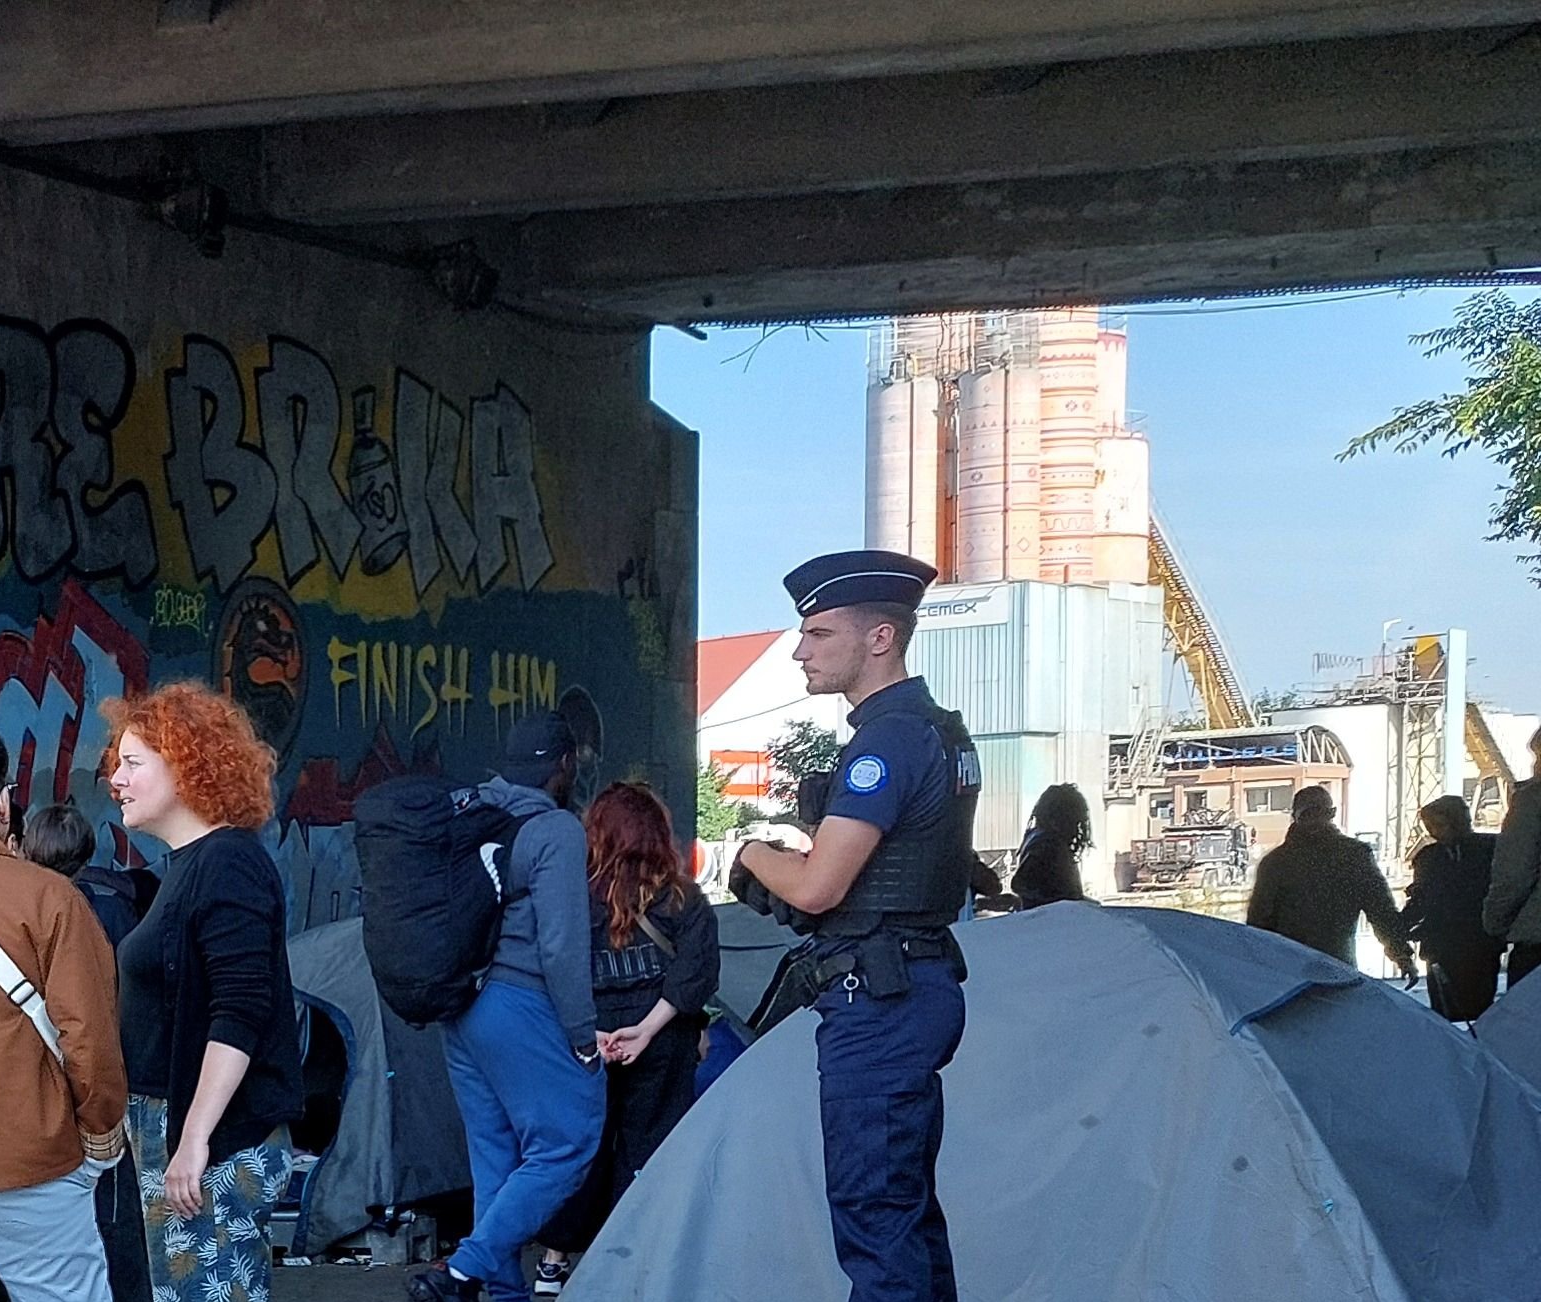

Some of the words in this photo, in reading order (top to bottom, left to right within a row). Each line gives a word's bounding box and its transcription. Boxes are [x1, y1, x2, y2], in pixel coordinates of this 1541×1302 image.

[917, 602, 977, 617] CEMEX
[327, 634, 474, 742] FINISH
[488, 649, 557, 742] HIM
